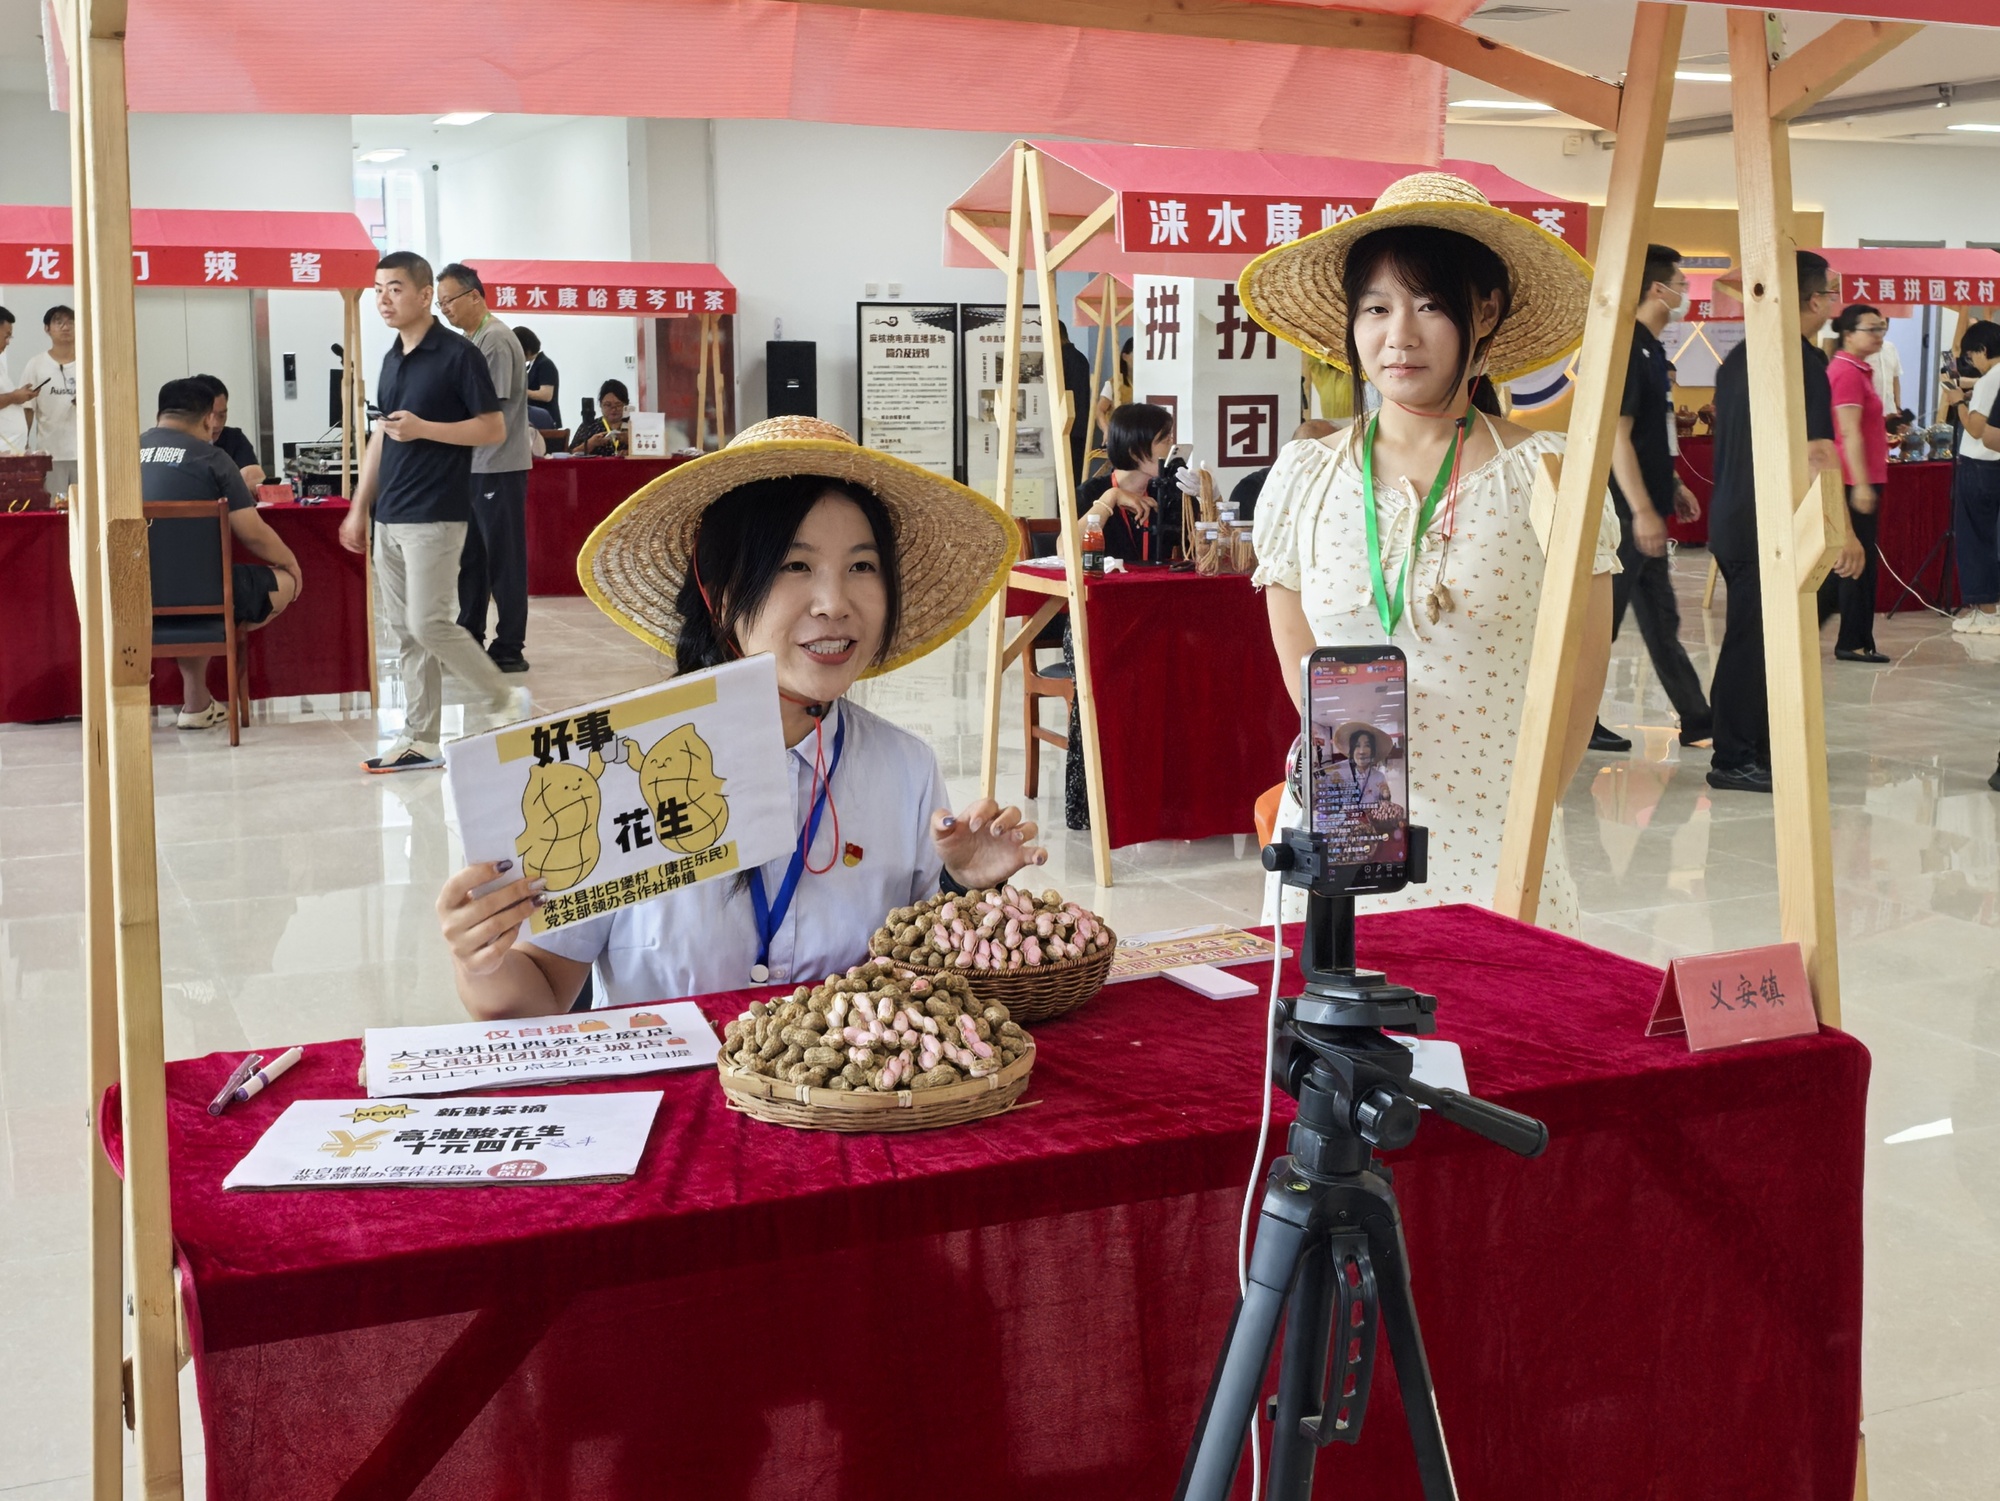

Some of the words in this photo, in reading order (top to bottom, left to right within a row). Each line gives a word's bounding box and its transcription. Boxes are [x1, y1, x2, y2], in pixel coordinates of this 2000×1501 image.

[496, 286, 724, 311] 涞水康峪黄芩叶茶
[1852, 278, 1995, 303] 大禹拼团农村
[531, 709, 615, 767] 好事
[613, 797, 694, 853] 花生
[545, 869, 697, 929] 党支部领办合作社种植
[1710, 968, 1785, 1011] 义安镇
[484, 1024, 577, 1040] 仅自提
[409, 1039, 663, 1070] 大禹拼团新东城店
[389, 1075, 413, 1083] 24
[356, 1109, 405, 1118] NEW!
[435, 1104, 548, 1117] 新鲜采摘
[393, 1125, 566, 1142] 高油酸花生
[403, 1138, 542, 1156] 十元四斤
